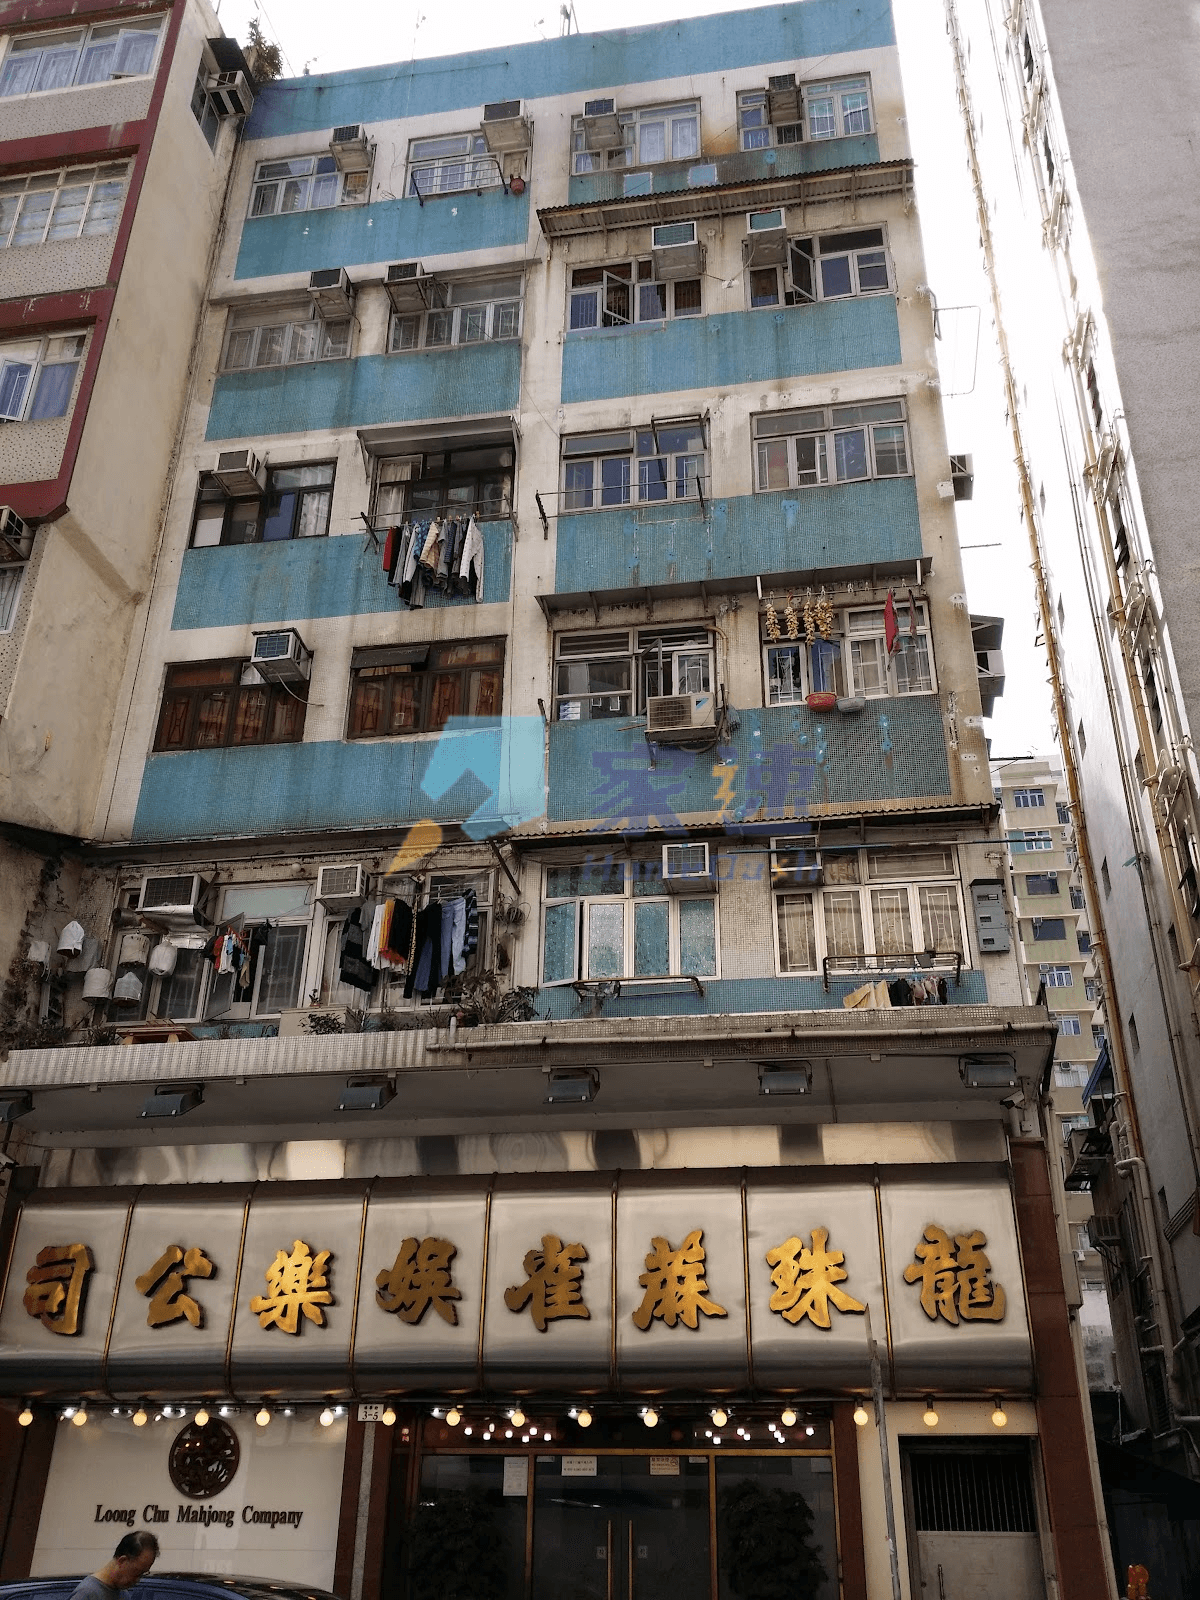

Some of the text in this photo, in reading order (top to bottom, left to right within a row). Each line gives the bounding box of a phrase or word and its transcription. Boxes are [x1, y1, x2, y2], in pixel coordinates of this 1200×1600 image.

[94, 1504, 304, 1528] Loong Chu Mahjong Company
